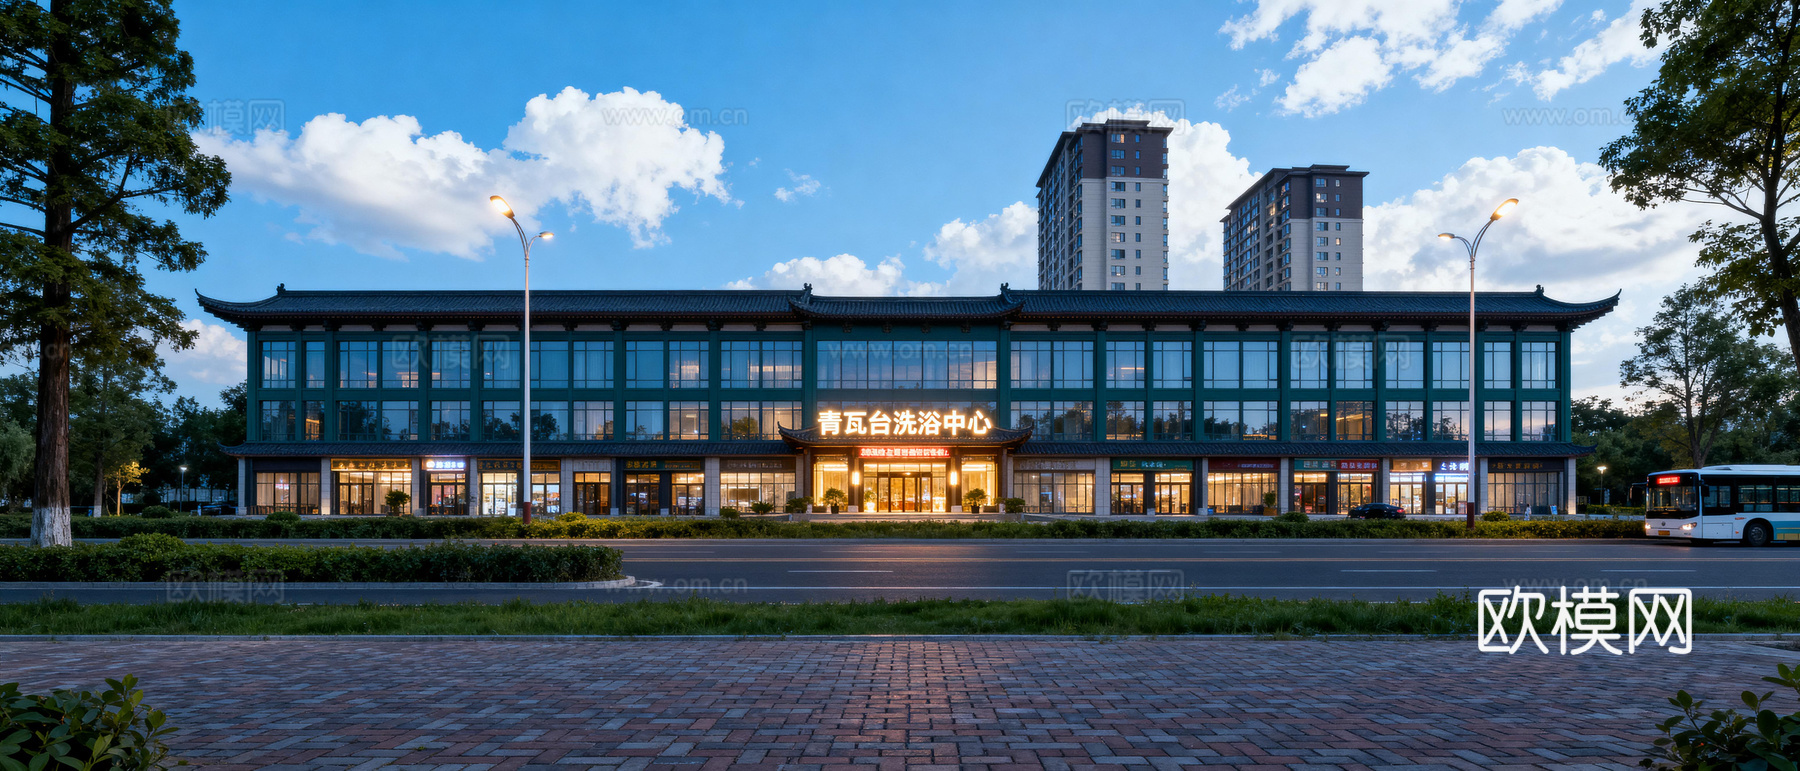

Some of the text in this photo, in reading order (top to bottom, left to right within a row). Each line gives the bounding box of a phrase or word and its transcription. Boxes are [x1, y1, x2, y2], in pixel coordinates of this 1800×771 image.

[818, 410, 992, 436] 青瓦台洗浴中心
